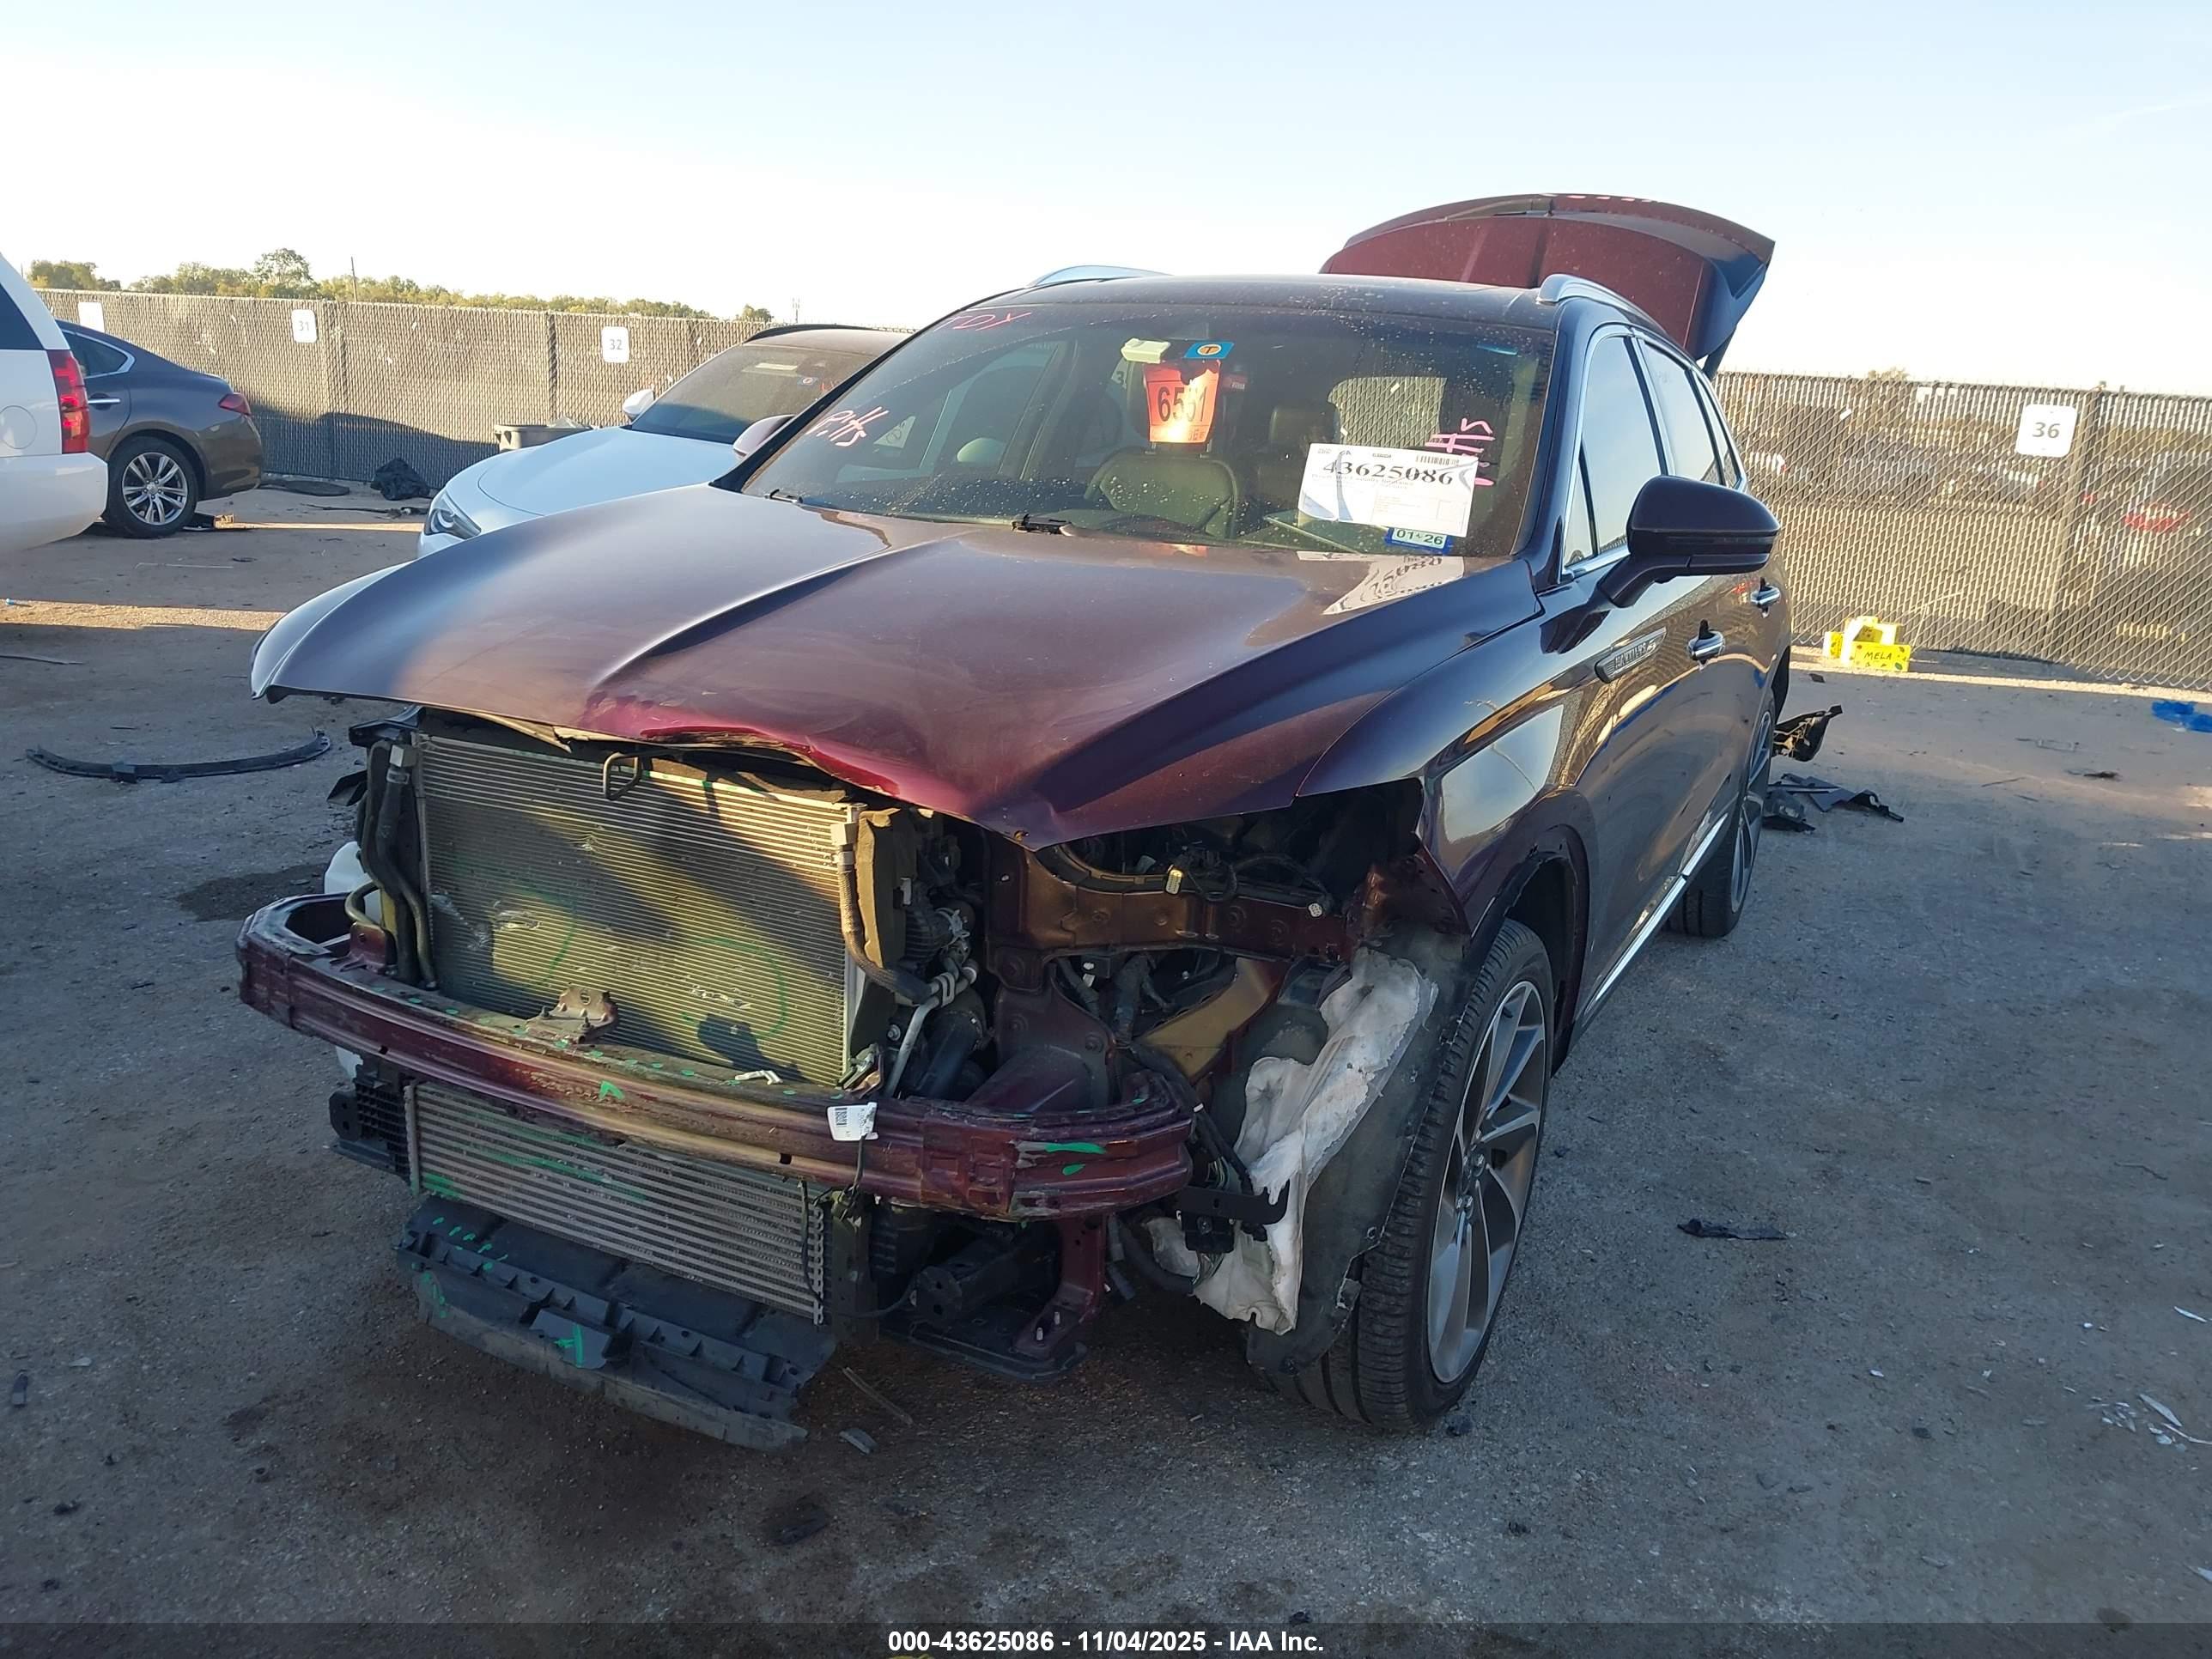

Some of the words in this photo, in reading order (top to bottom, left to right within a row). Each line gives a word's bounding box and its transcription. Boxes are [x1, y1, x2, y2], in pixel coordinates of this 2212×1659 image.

[298, 320, 310, 331] 31
[610, 338, 623, 350] 32
[2032, 422, 2061, 439] 36
[1323, 459, 1453, 485] 43625086
